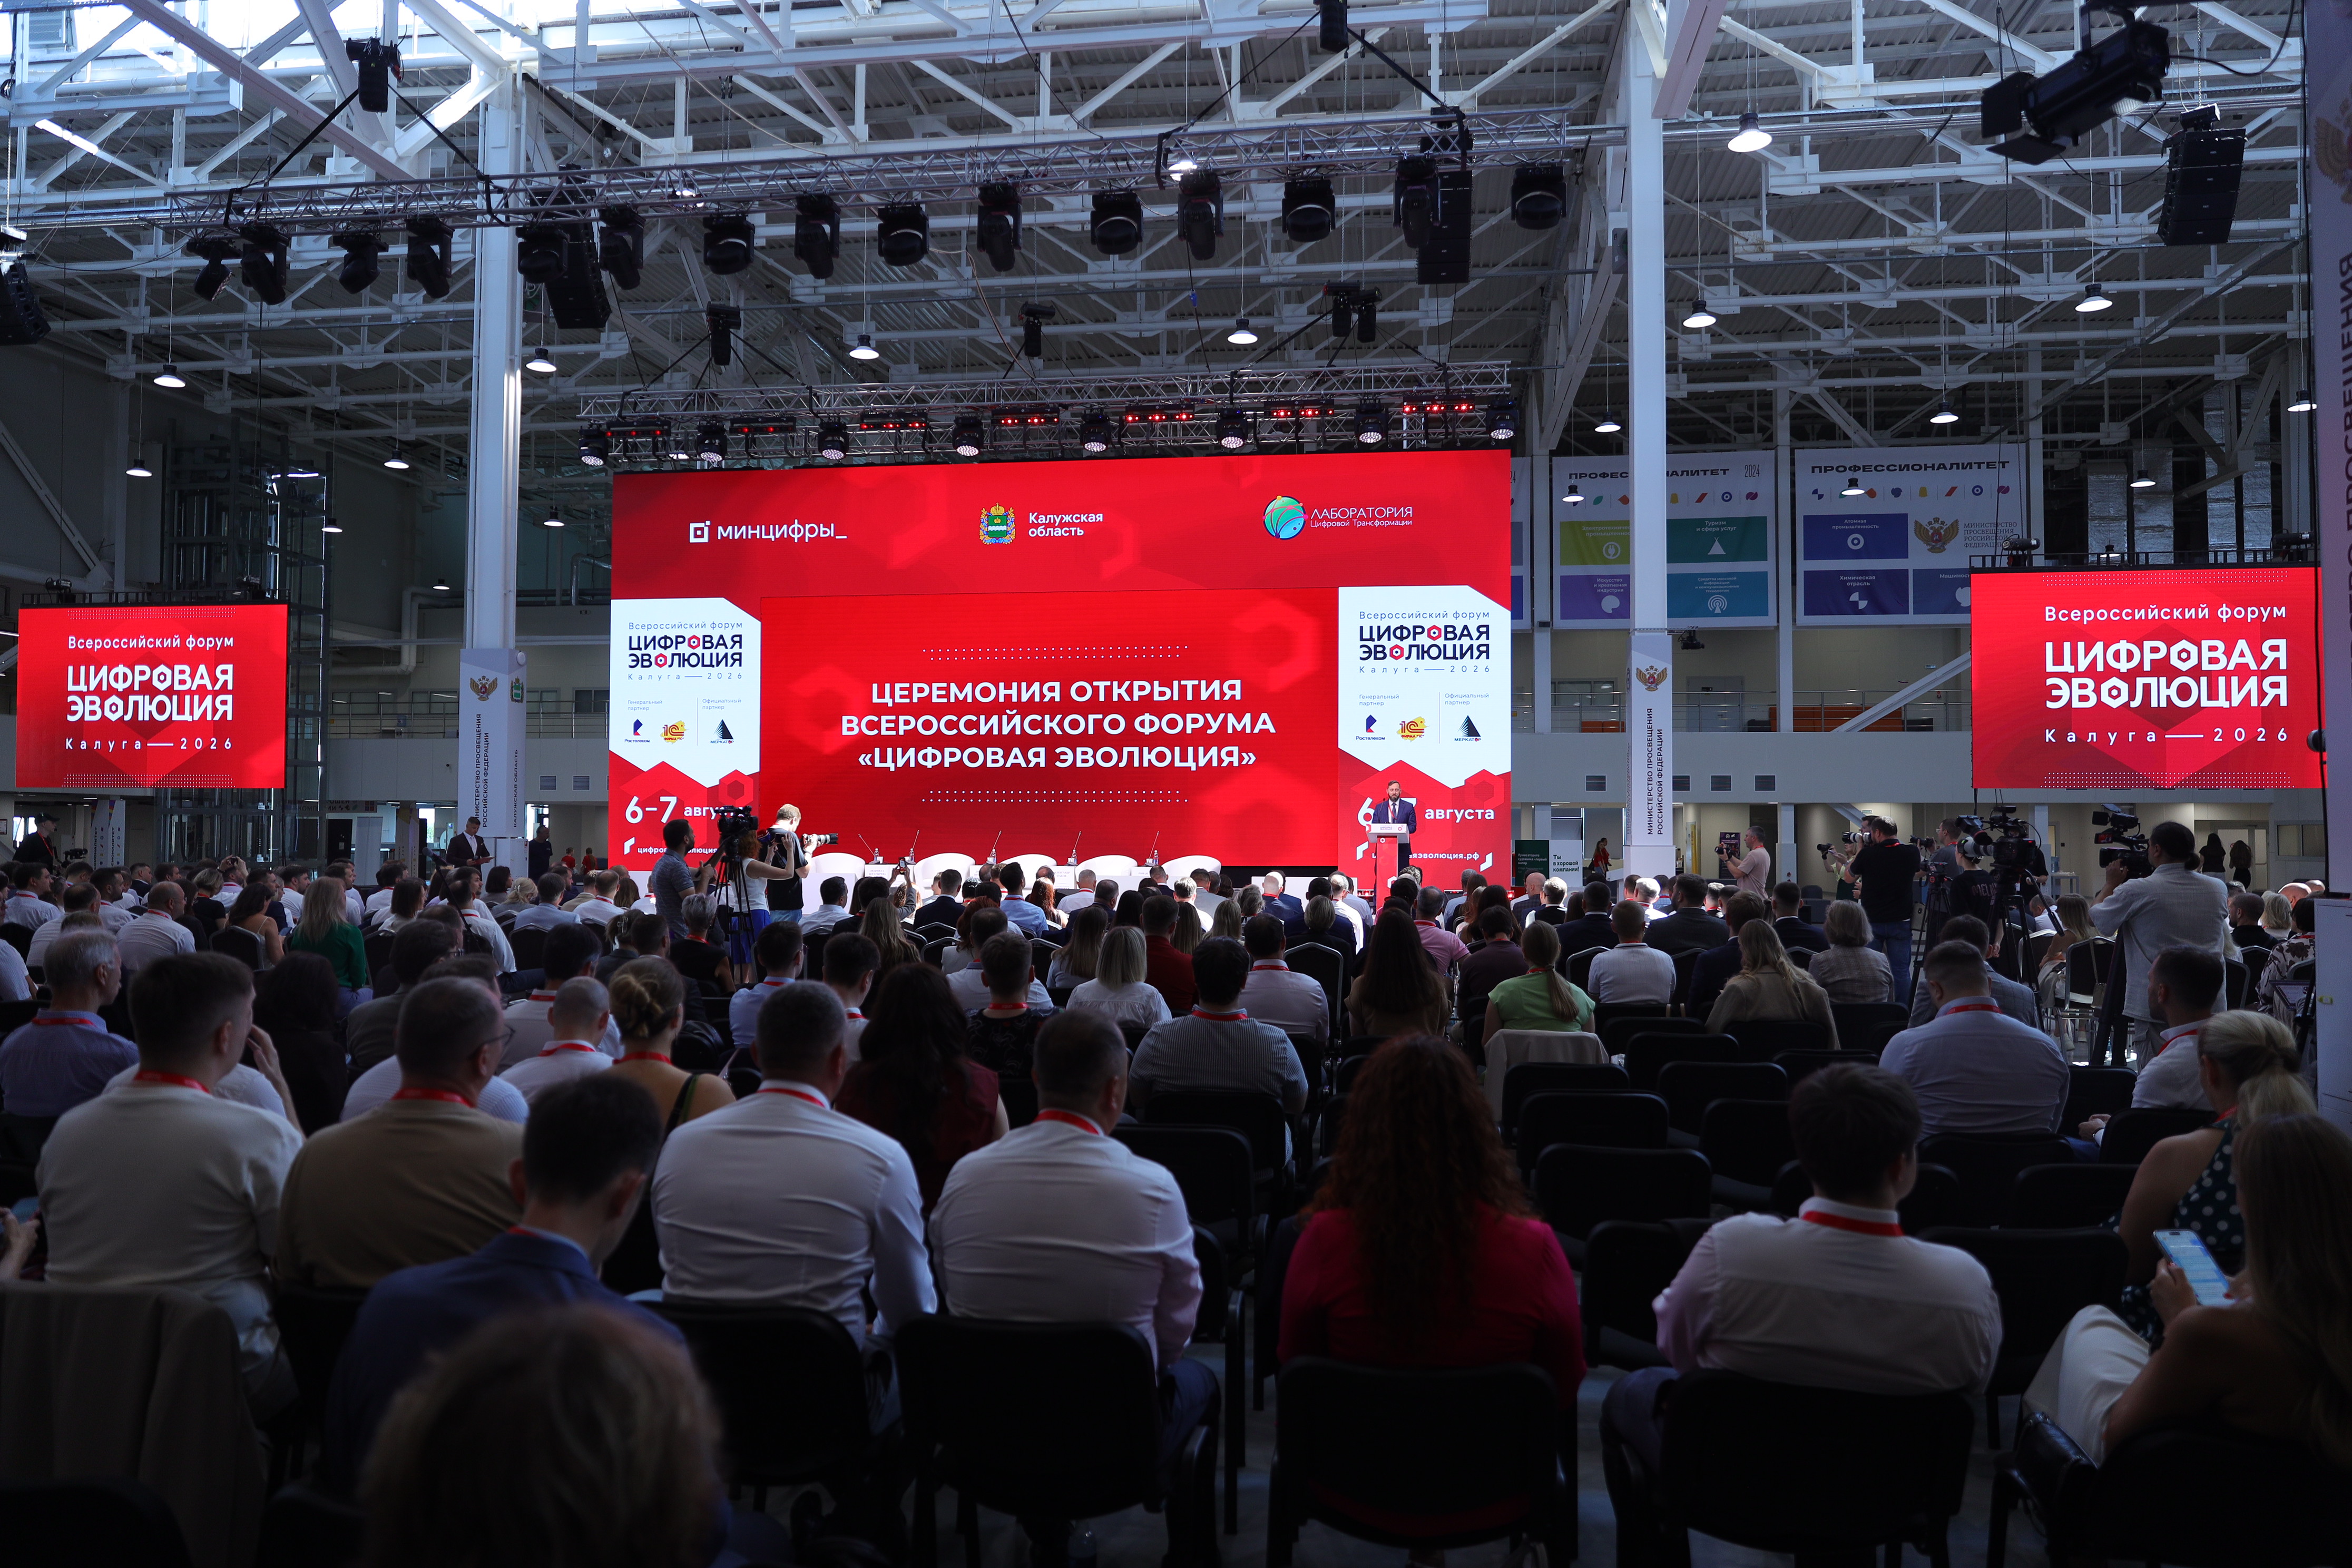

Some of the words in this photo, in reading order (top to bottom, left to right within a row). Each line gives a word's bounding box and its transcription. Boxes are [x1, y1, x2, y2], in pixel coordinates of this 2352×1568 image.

[1745, 464, 1759, 477] 2024
[1811, 461, 2010, 473] ПРОФЕССИОНАЛИТЕТ
[1029, 513, 1103, 525] Калужская
[1311, 507, 1413, 518] ЛАБОРАТОРИЯ
[1028, 525, 1084, 537] область
[1310, 519, 1350, 528] Цифровой
[1353, 519, 1412, 528] Трансформации
[1359, 611, 1448, 621] Всероссийский
[1453, 610, 1489, 620] форум
[2045, 604, 2209, 625] Всероссийский
[2217, 603, 2287, 623] форум
[629, 622, 706, 631] Всероссийский
[710, 621, 742, 630] форум
[1359, 624, 1489, 642] ЦИФРОВАЯ
[68, 635, 180, 651] Всероссийский
[185, 635, 233, 651] форум
[629, 634, 742, 651] ЦИФРОВАЯ
[628, 652, 742, 668] ЭВОЛЮЦИЯ
[1359, 643, 1489, 661] ЭВОЛЮЦИЯ
[2045, 639, 2287, 673] ЦИФРОВАЯ
[67, 664, 233, 692] ЦИФРОВАЯ
[1359, 666, 1419, 674] Калуга
[871, 681, 1060, 707] ЦЕРЕМОНИЯ
[1070, 680, 1242, 702] ОТКРЫТИЯ
[2045, 675, 2287, 709] ЭВОЛЮЦИЯ
[67, 694, 233, 722] ЭВОЛЮЦИЯ
[841, 710, 1126, 736] ВСЕРОССИЙСКОГО
[1134, 712, 1276, 735] ФОРУМА
[65, 738, 141, 752] Калуга
[180, 738, 232, 750] 2026
[2045, 729, 2156, 746] Калуга
[2213, 728, 2287, 742] 2026
[858, 747, 1046, 771] «ЦИФРОВАЯ
[1055, 746, 1257, 771] ЭВОЛЮЦИЯ»
[684, 807, 744, 820] авгу
[1425, 809, 1494, 823] августа
